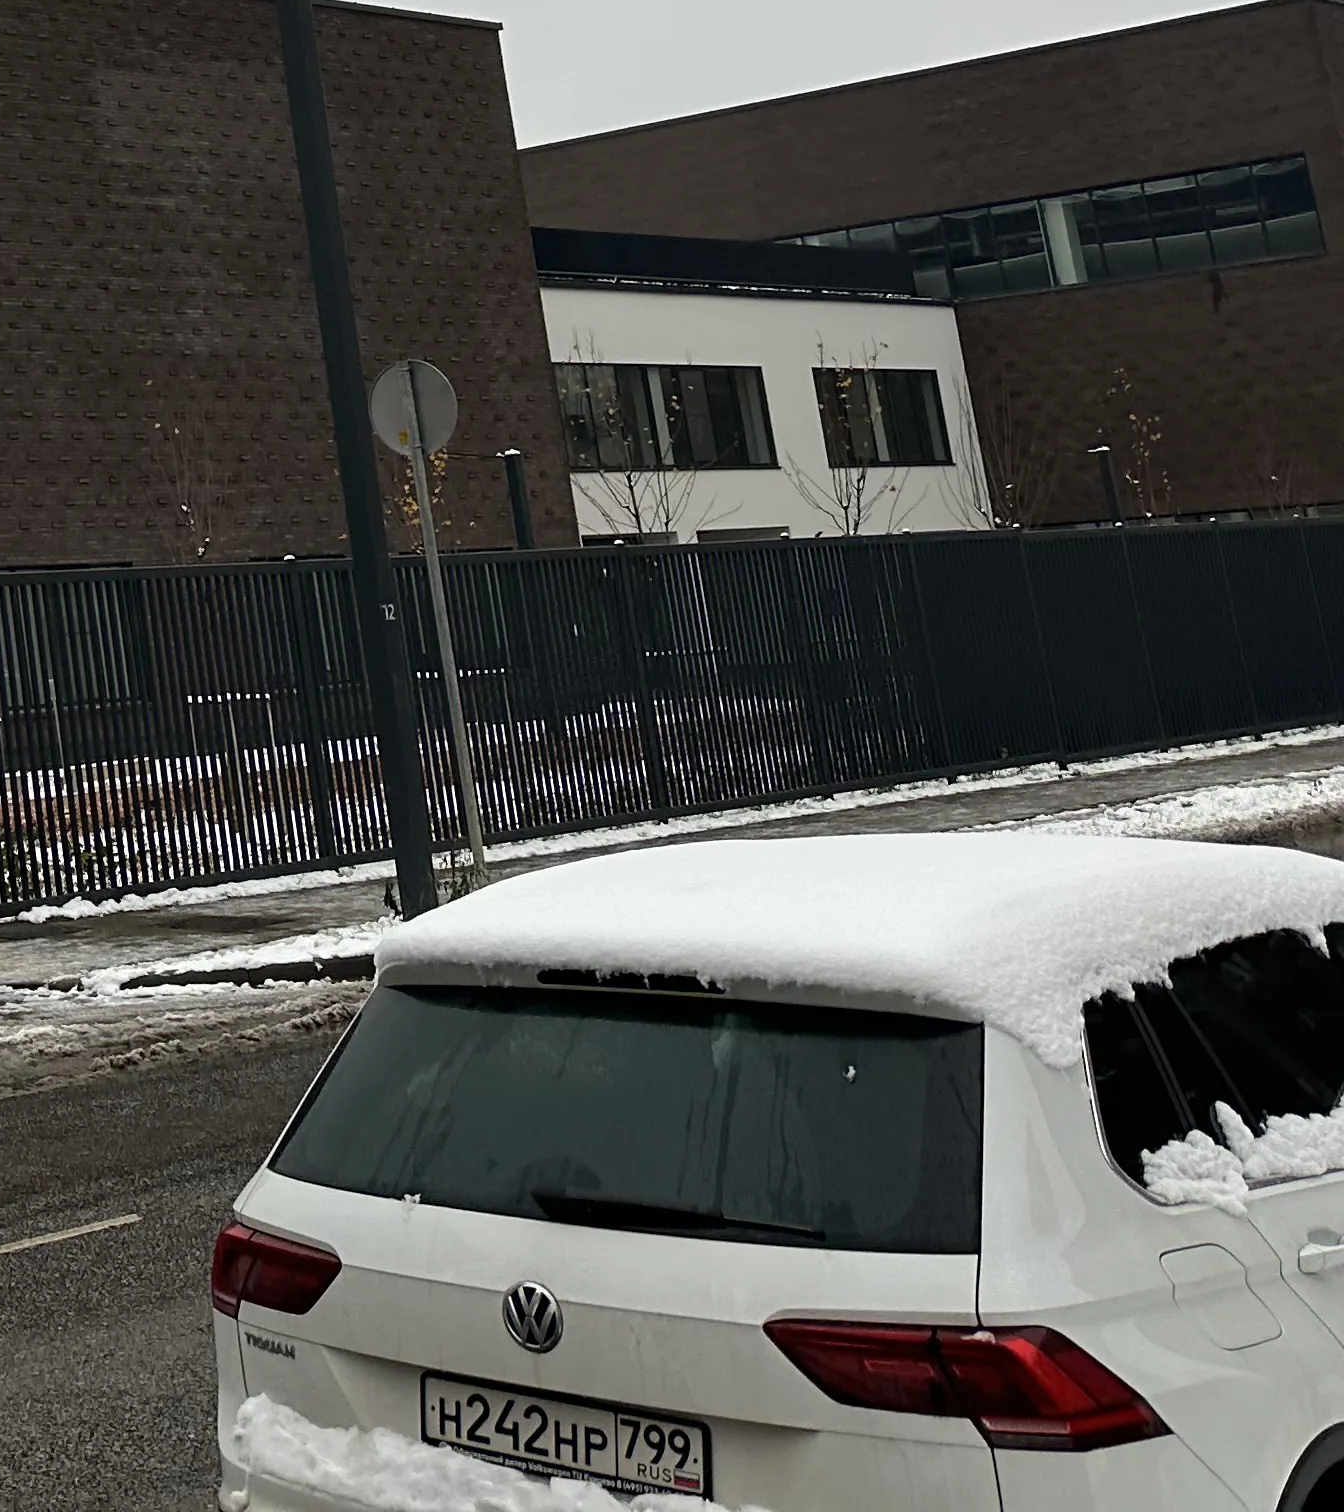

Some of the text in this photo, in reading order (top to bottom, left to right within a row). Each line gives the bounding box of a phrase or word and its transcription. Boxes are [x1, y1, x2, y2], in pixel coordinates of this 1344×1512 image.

[243, 1331, 296, 1361] TIGUAN
[619, 1418, 692, 1470] 799
[637, 1462, 672, 1484] RUS
